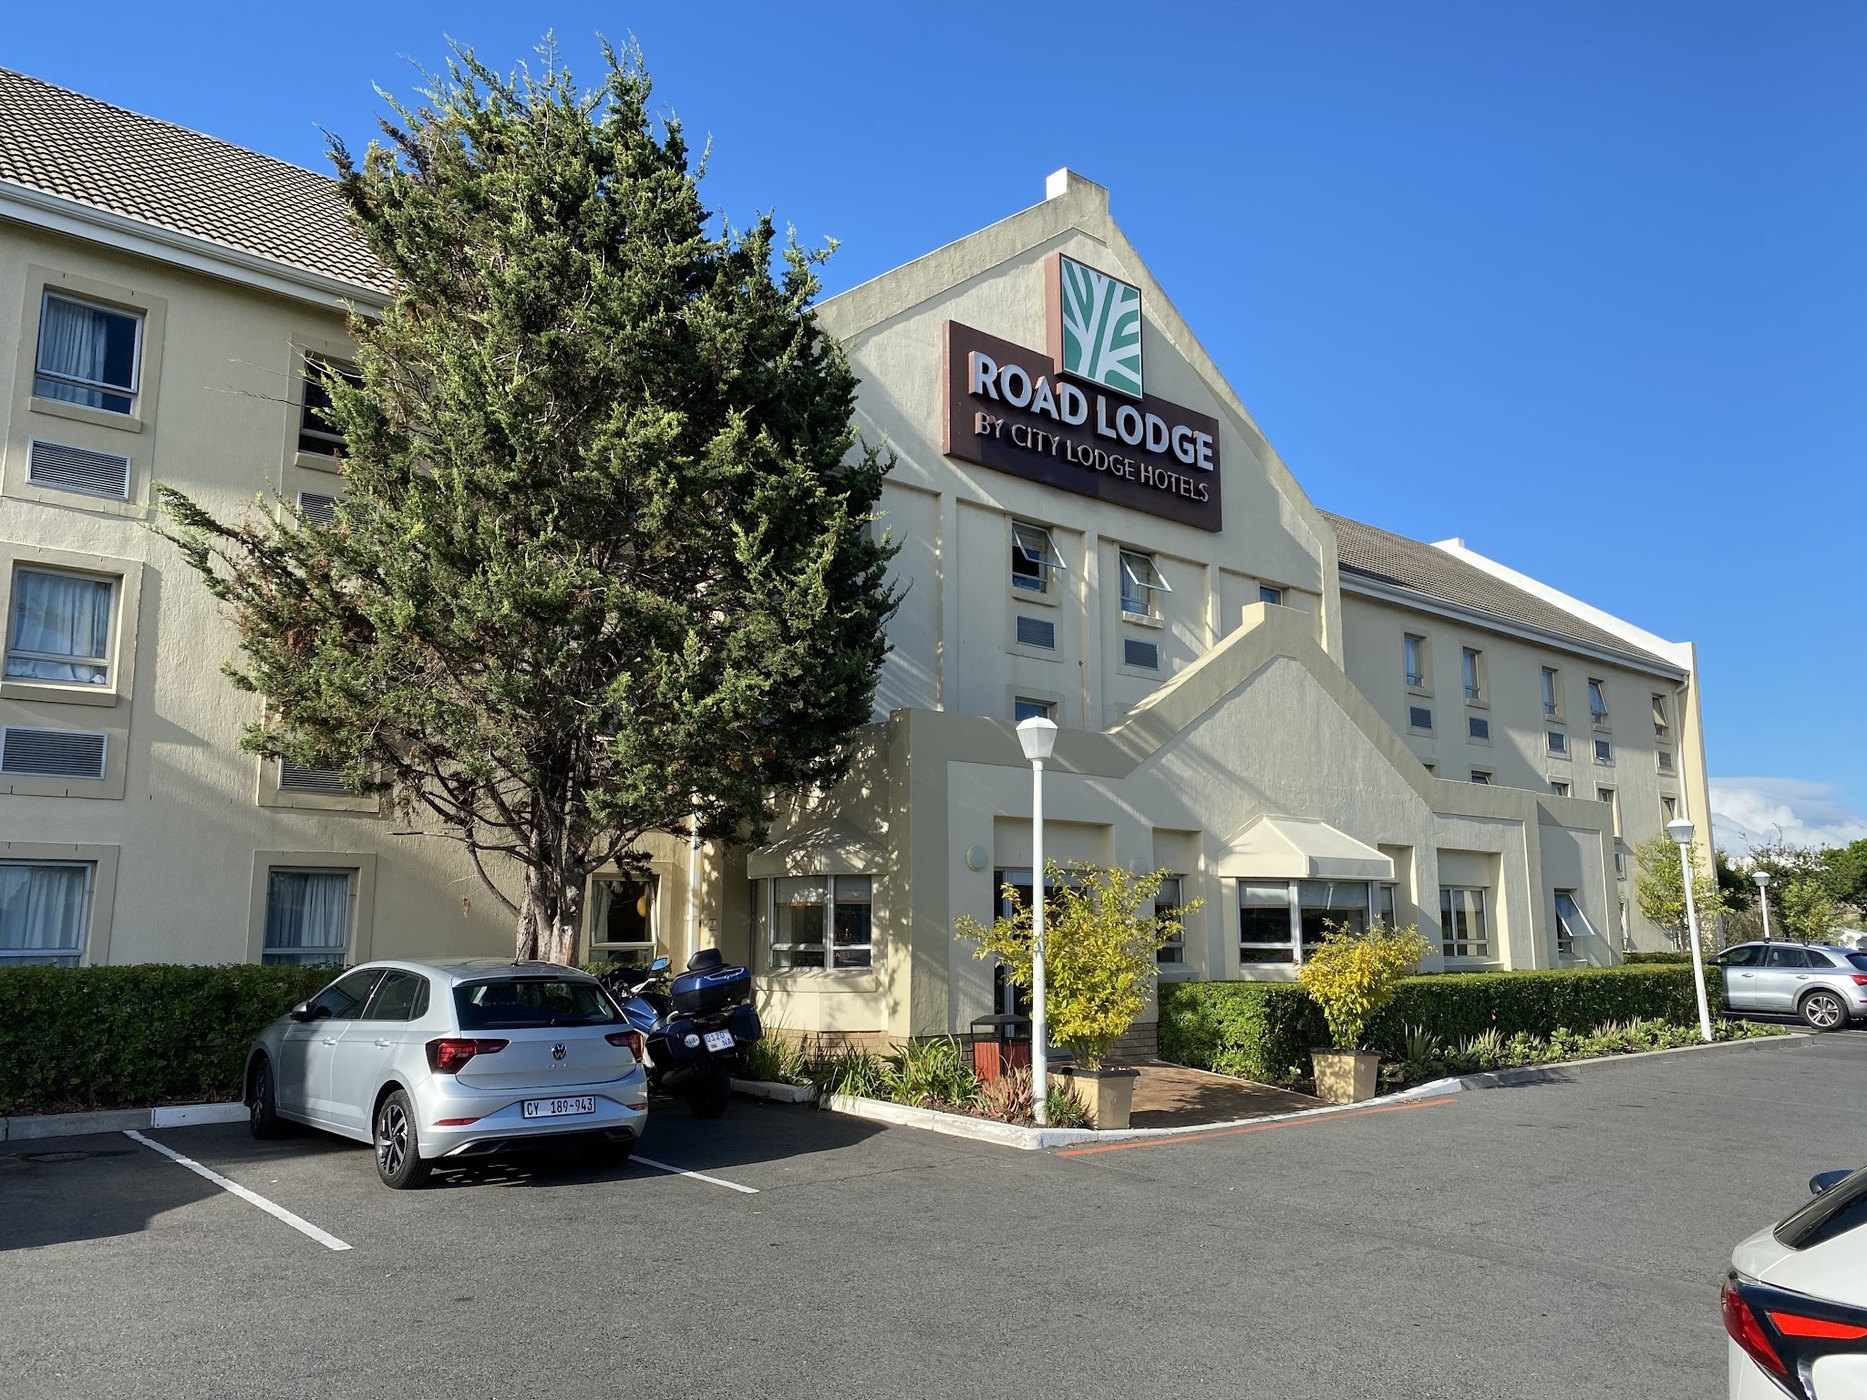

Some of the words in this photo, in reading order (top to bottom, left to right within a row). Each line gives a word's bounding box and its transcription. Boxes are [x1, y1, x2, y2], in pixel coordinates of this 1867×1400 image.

[969, 350, 1088, 426] ROAD
[1096, 394, 1214, 471] LODGE
[975, 411, 1004, 439] BY
[1011, 424, 1060, 456] CITY
[1066, 439, 1135, 480] LODGE
[1140, 462, 1209, 502] HOTELS
[527, 1102, 539, 1115] CY
[550, 1098, 593, 1114] 189-943
